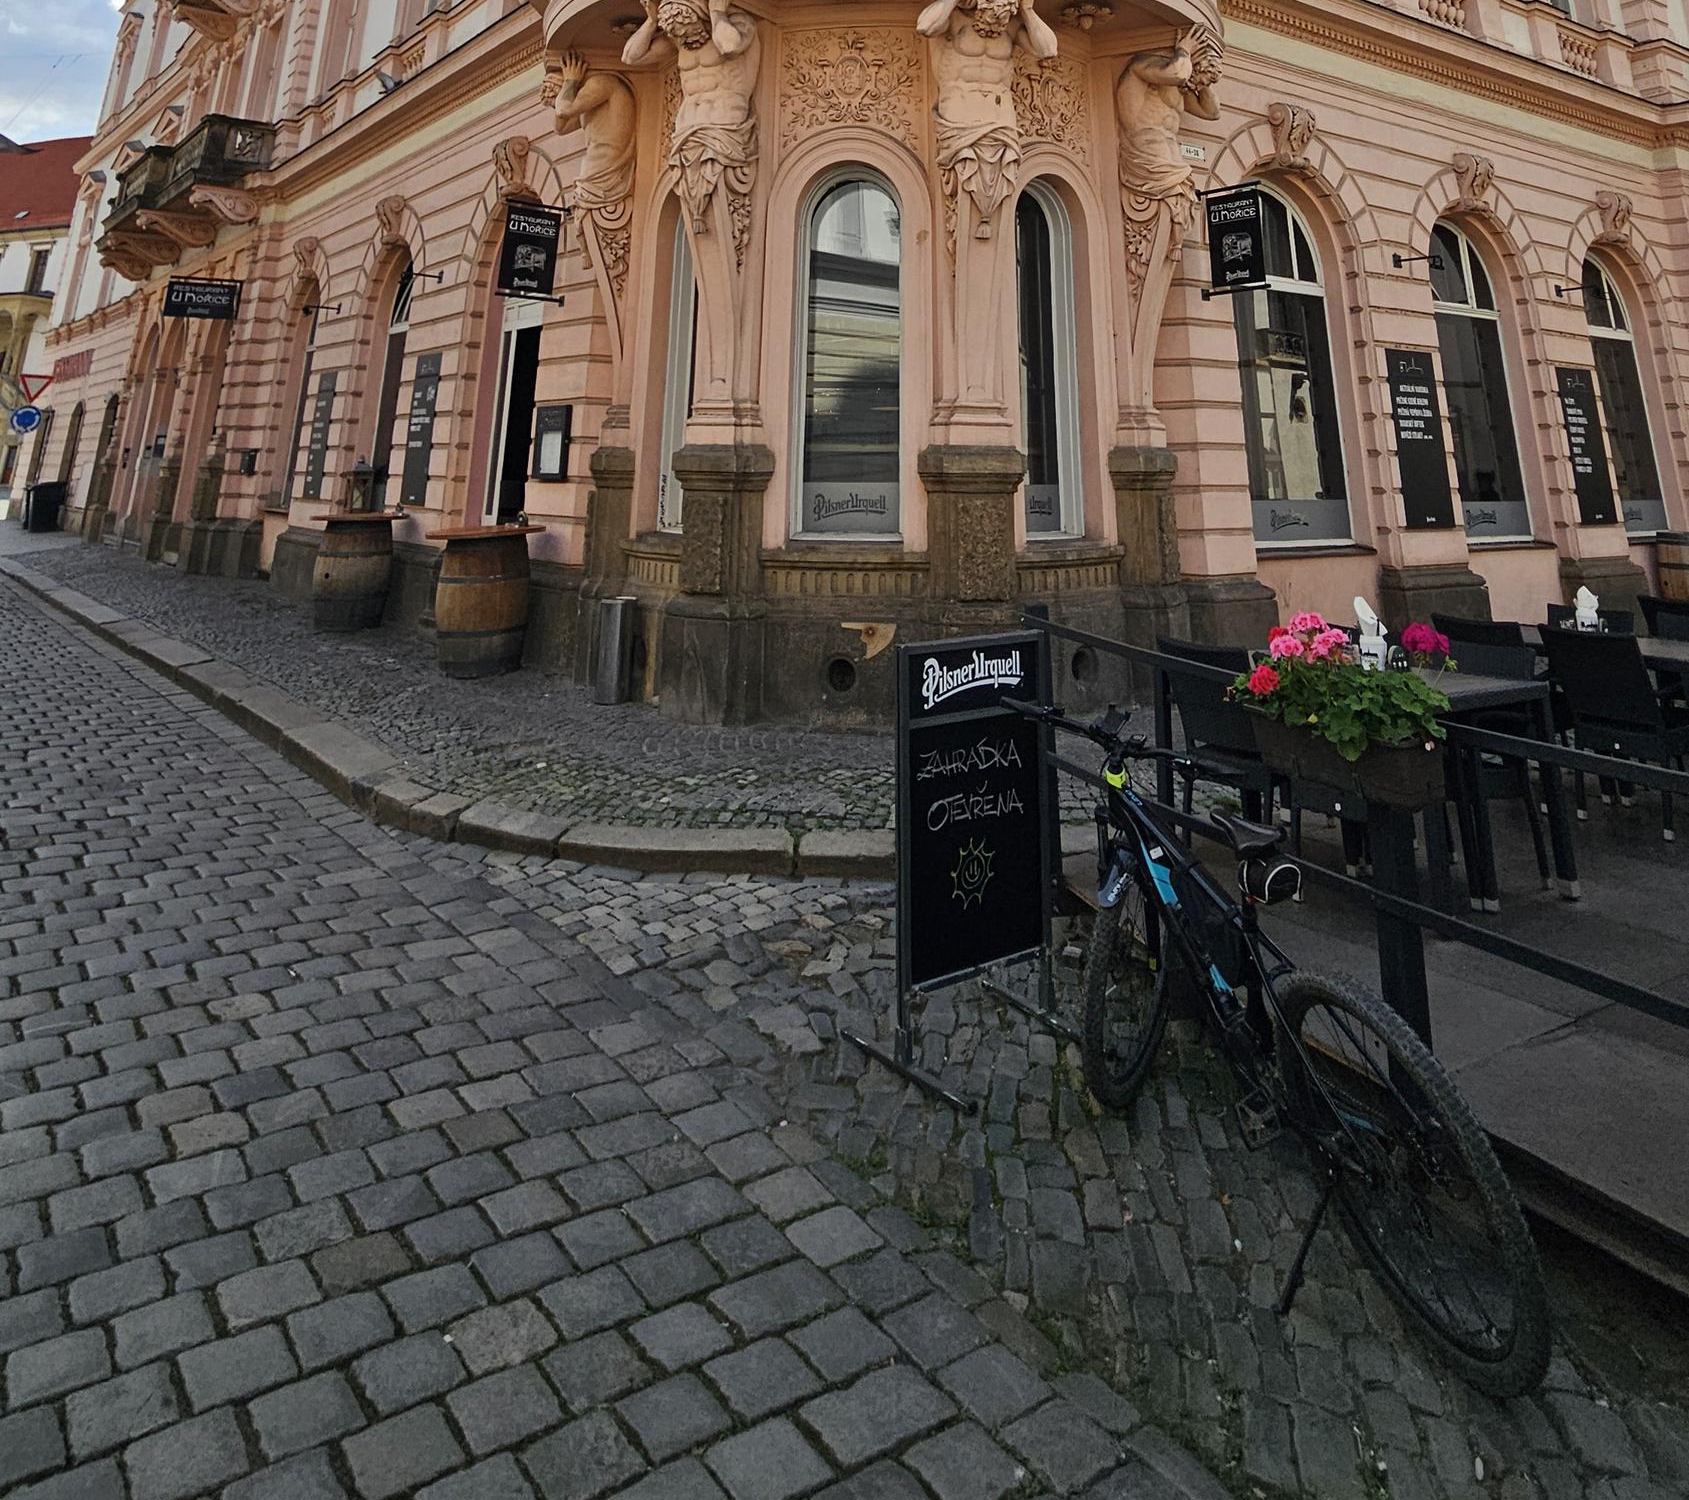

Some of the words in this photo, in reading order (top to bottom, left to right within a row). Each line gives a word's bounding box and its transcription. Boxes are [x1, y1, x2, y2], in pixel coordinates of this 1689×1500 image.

[1210, 199, 1254, 212] RESTAURANT
[510, 213, 555, 226] RESTAURANT
[1211, 211, 1219, 222] U
[509, 220, 518, 230] U
[171, 291, 182, 302] U
[813, 493, 851, 521] Pilsner
[921, 657, 976, 710] Pilsner
[916, 737, 1022, 781] ZAHRÁDKA
[927, 780, 1024, 831] OTEVŘENA
